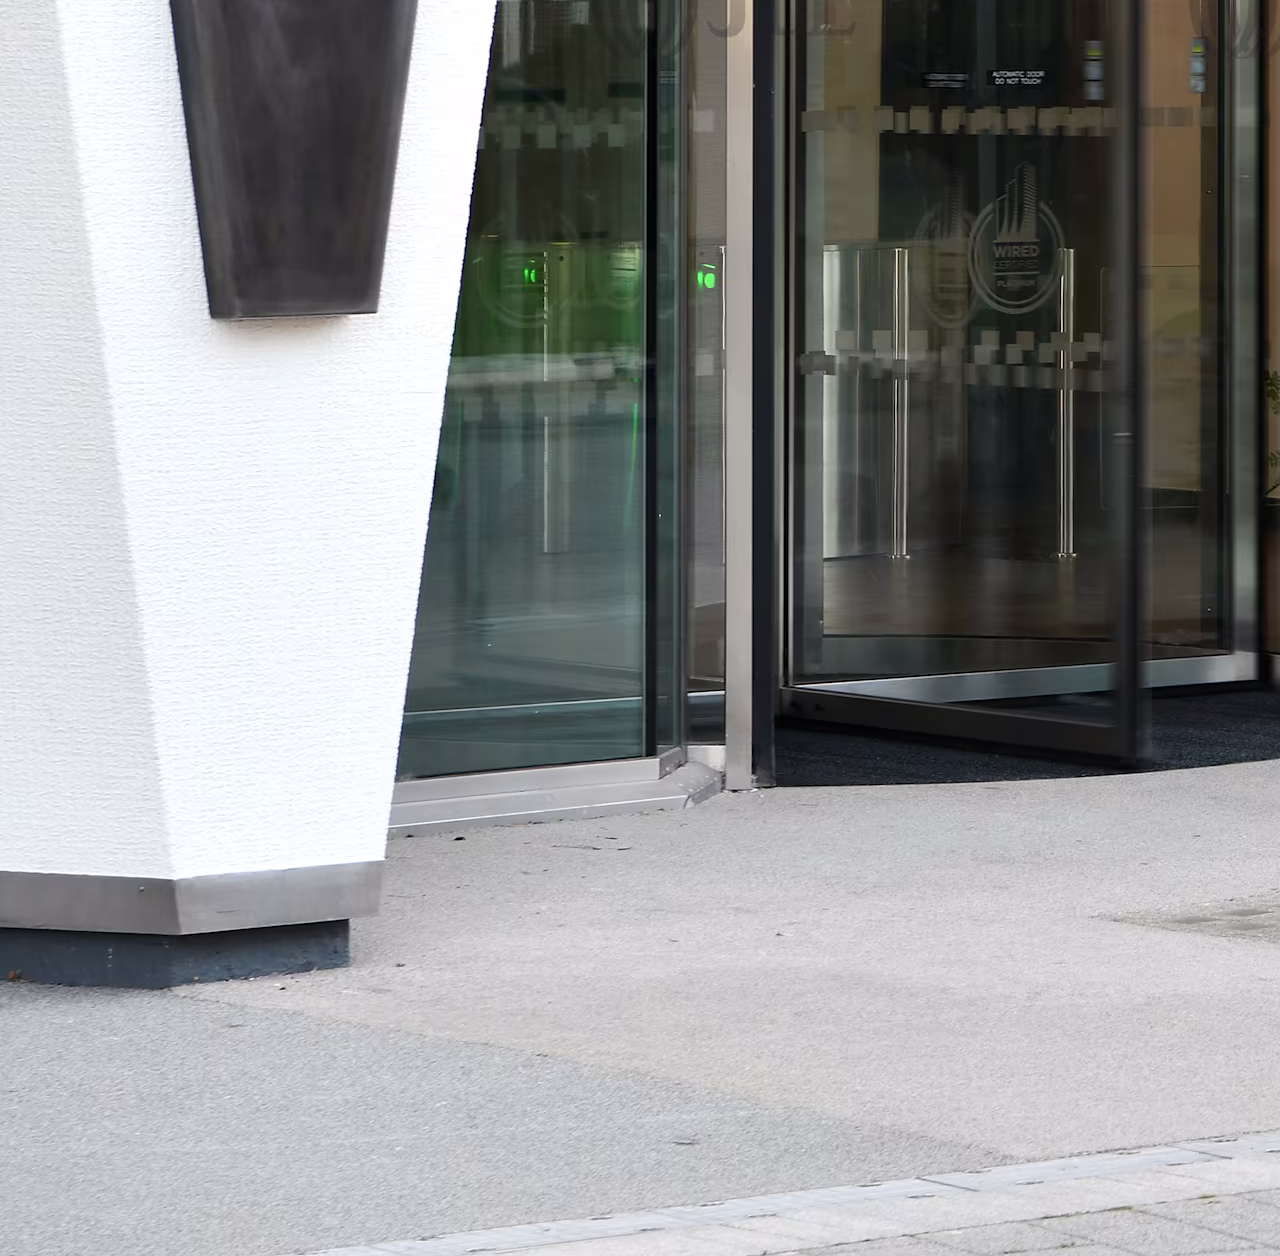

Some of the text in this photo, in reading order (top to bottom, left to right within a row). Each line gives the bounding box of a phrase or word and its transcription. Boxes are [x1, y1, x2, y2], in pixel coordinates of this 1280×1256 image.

[992, 70, 1045, 78] AUTOMATIC DOOR
[993, 245, 1040, 258] WIRED
